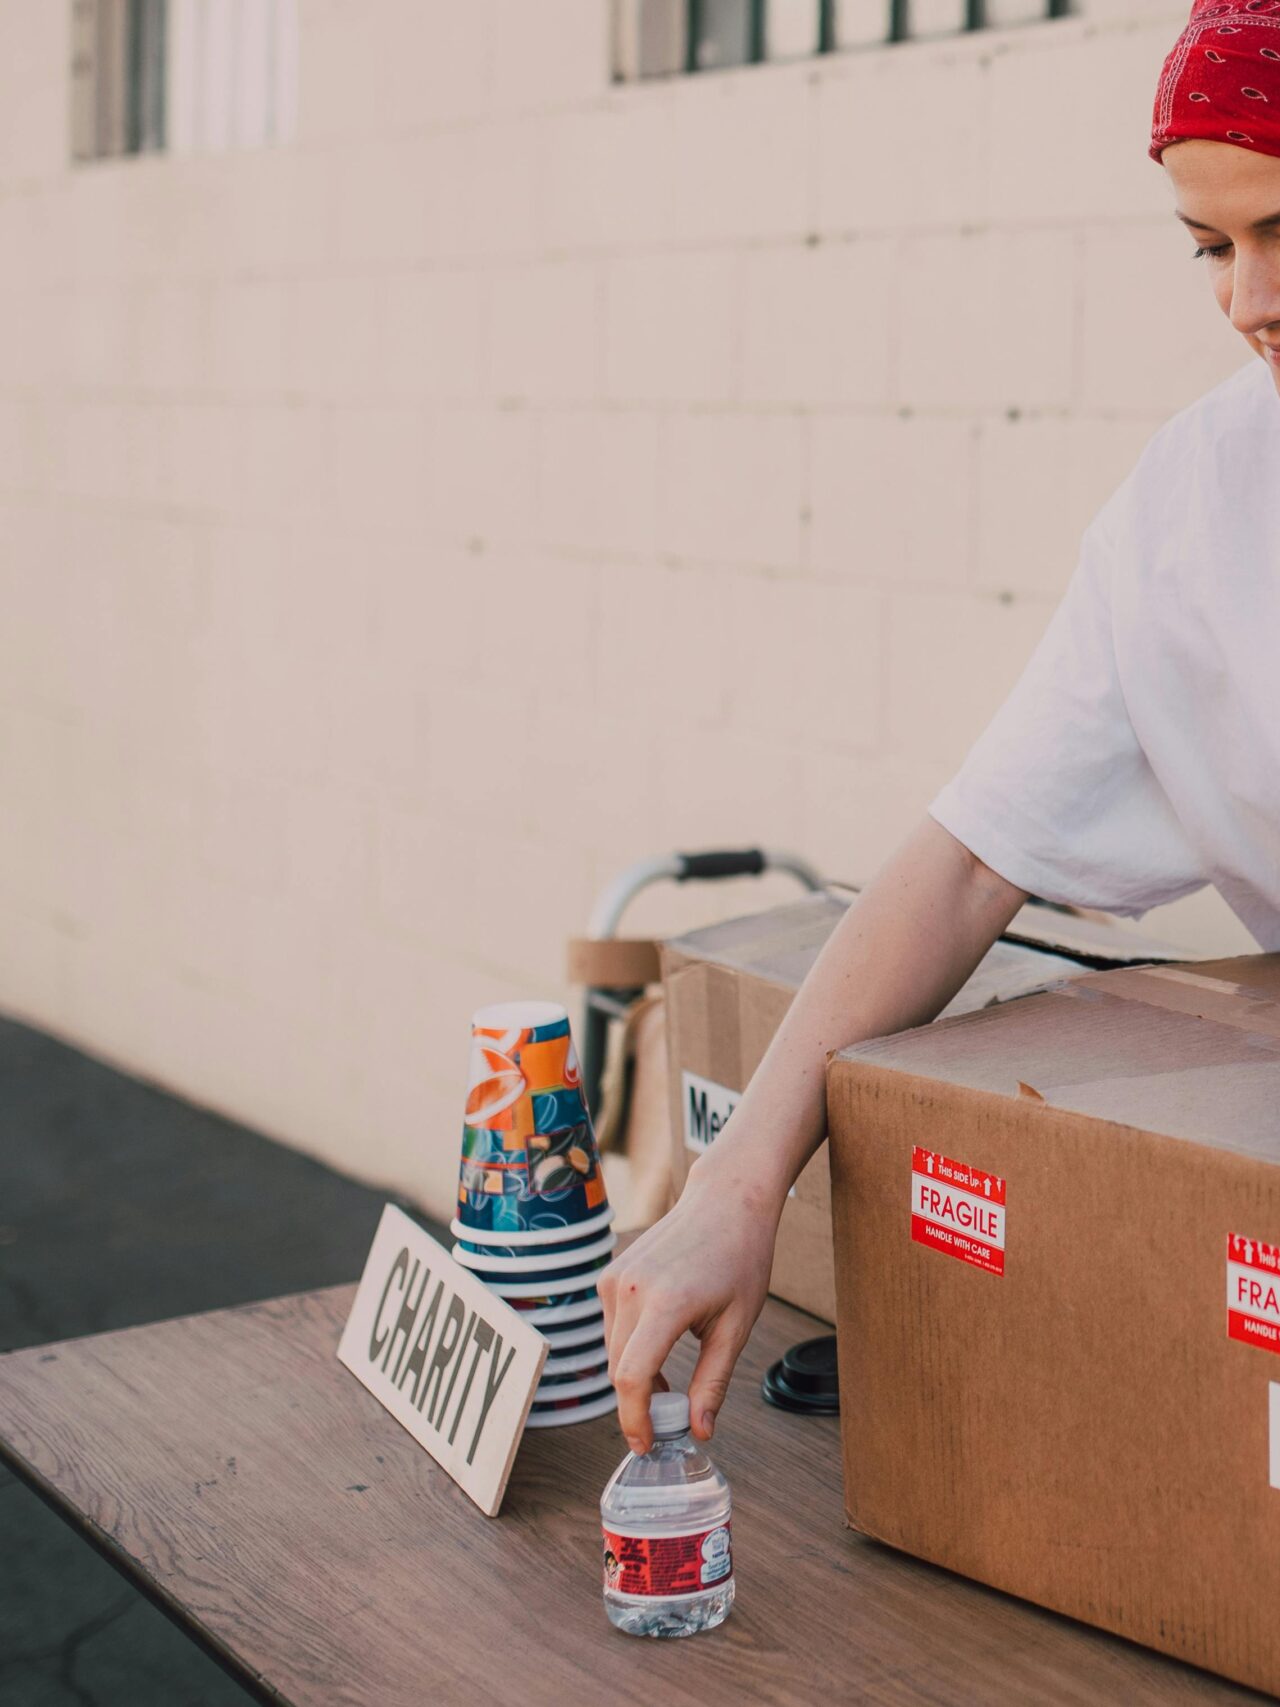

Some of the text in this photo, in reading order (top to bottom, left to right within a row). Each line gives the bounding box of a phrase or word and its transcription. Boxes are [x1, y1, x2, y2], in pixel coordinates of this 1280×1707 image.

[938, 1164, 953, 1178] THIS
[954, 1171, 969, 1184] SIDE
[920, 1185, 998, 1239] FRAGILE
[925, 1225, 991, 1260] HANDLE WITH CARE
[1259, 1253, 1276, 1268] THIS
[1244, 1320, 1277, 1341] HANDLE
[368, 1246, 517, 1466] CHARITY
